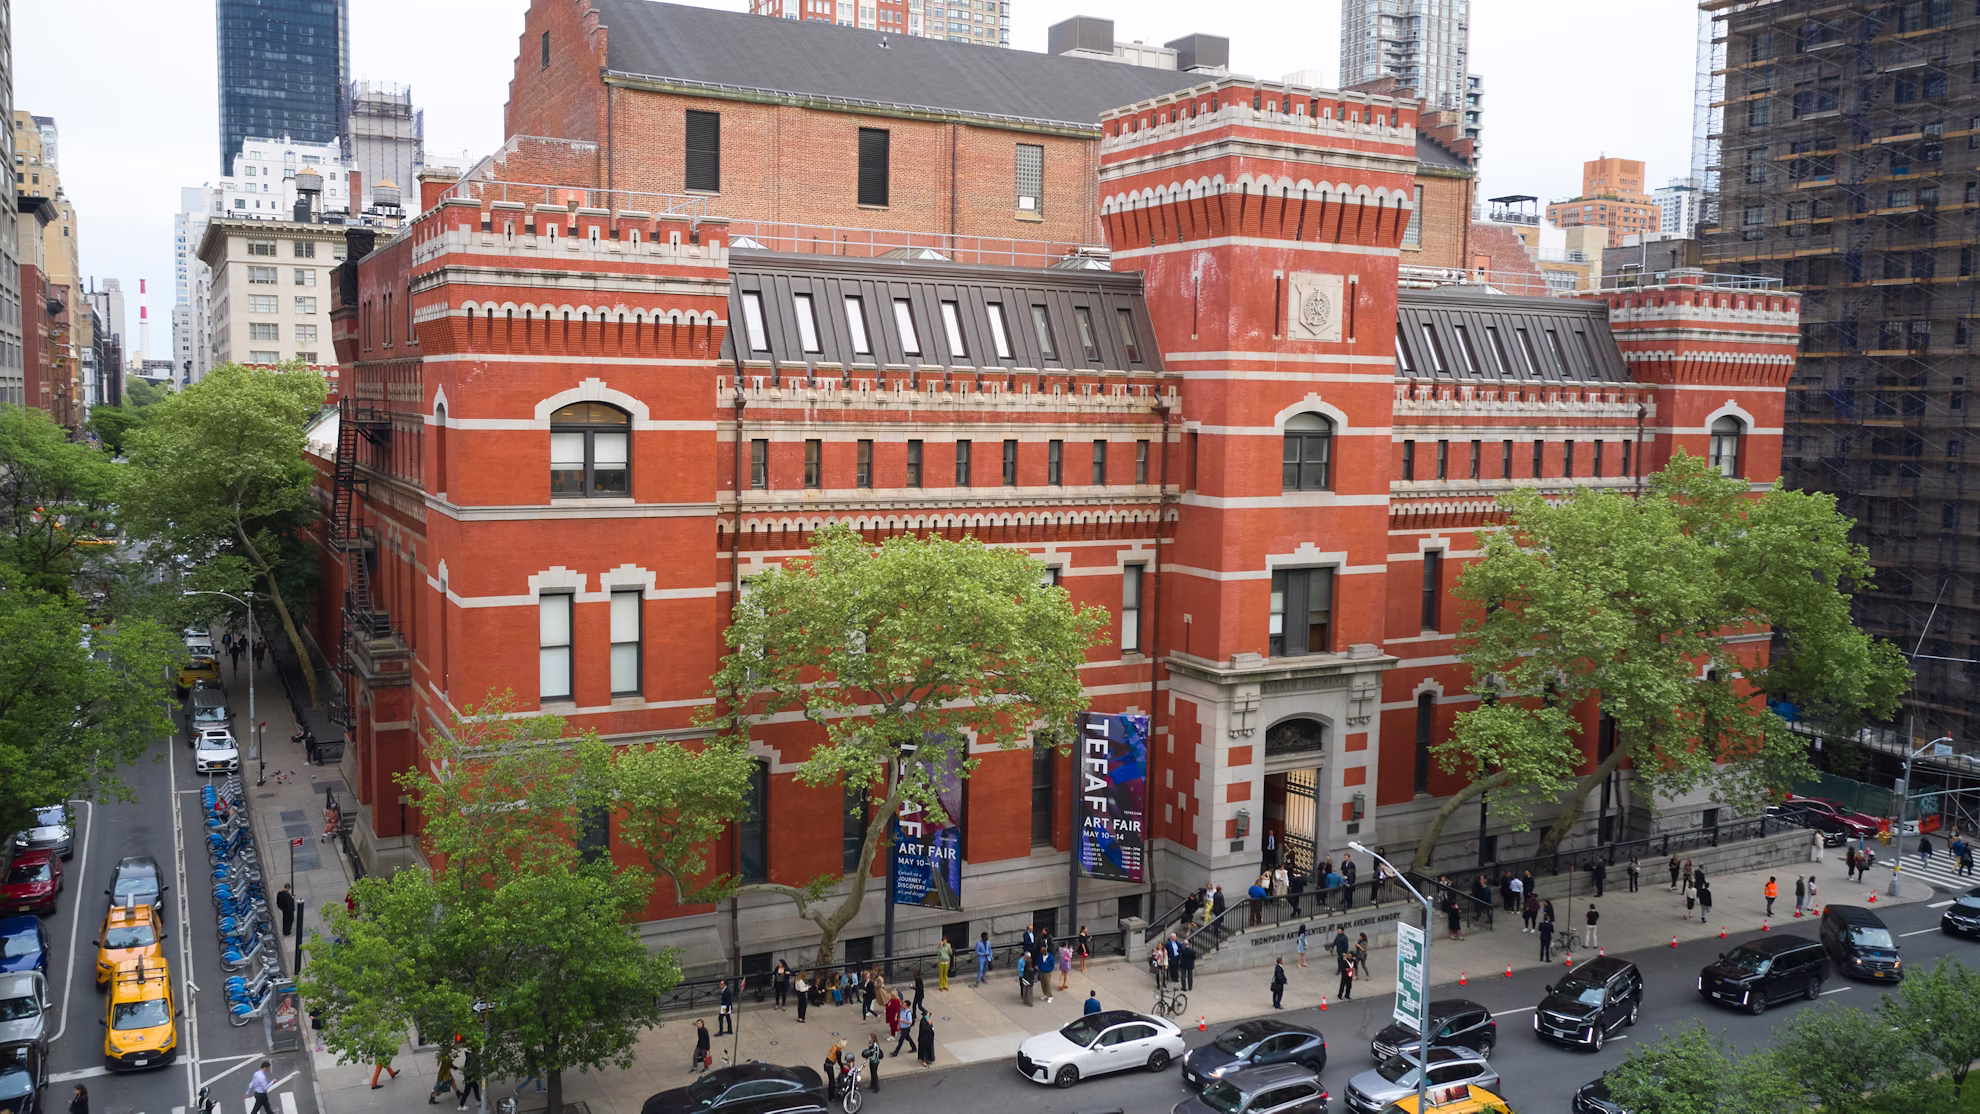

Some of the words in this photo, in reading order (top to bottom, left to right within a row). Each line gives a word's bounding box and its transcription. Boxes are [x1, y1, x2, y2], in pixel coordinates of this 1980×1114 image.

[1084, 720, 1109, 812] TEFAF
[1084, 816, 1109, 829] ART
[1114, 819, 1141, 832] FAIR
[899, 842, 924, 856] ART
[928, 846, 956, 860] FAIR
[898, 857, 914, 865] MAY
[898, 882, 926, 890] DISCOVERY
[1251, 933, 1285, 946] THOMPSON
[1337, 921, 1352, 930] PARK
[1353, 916, 1375, 927] AVENUE
[1377, 912, 1400, 922] ARMORY
